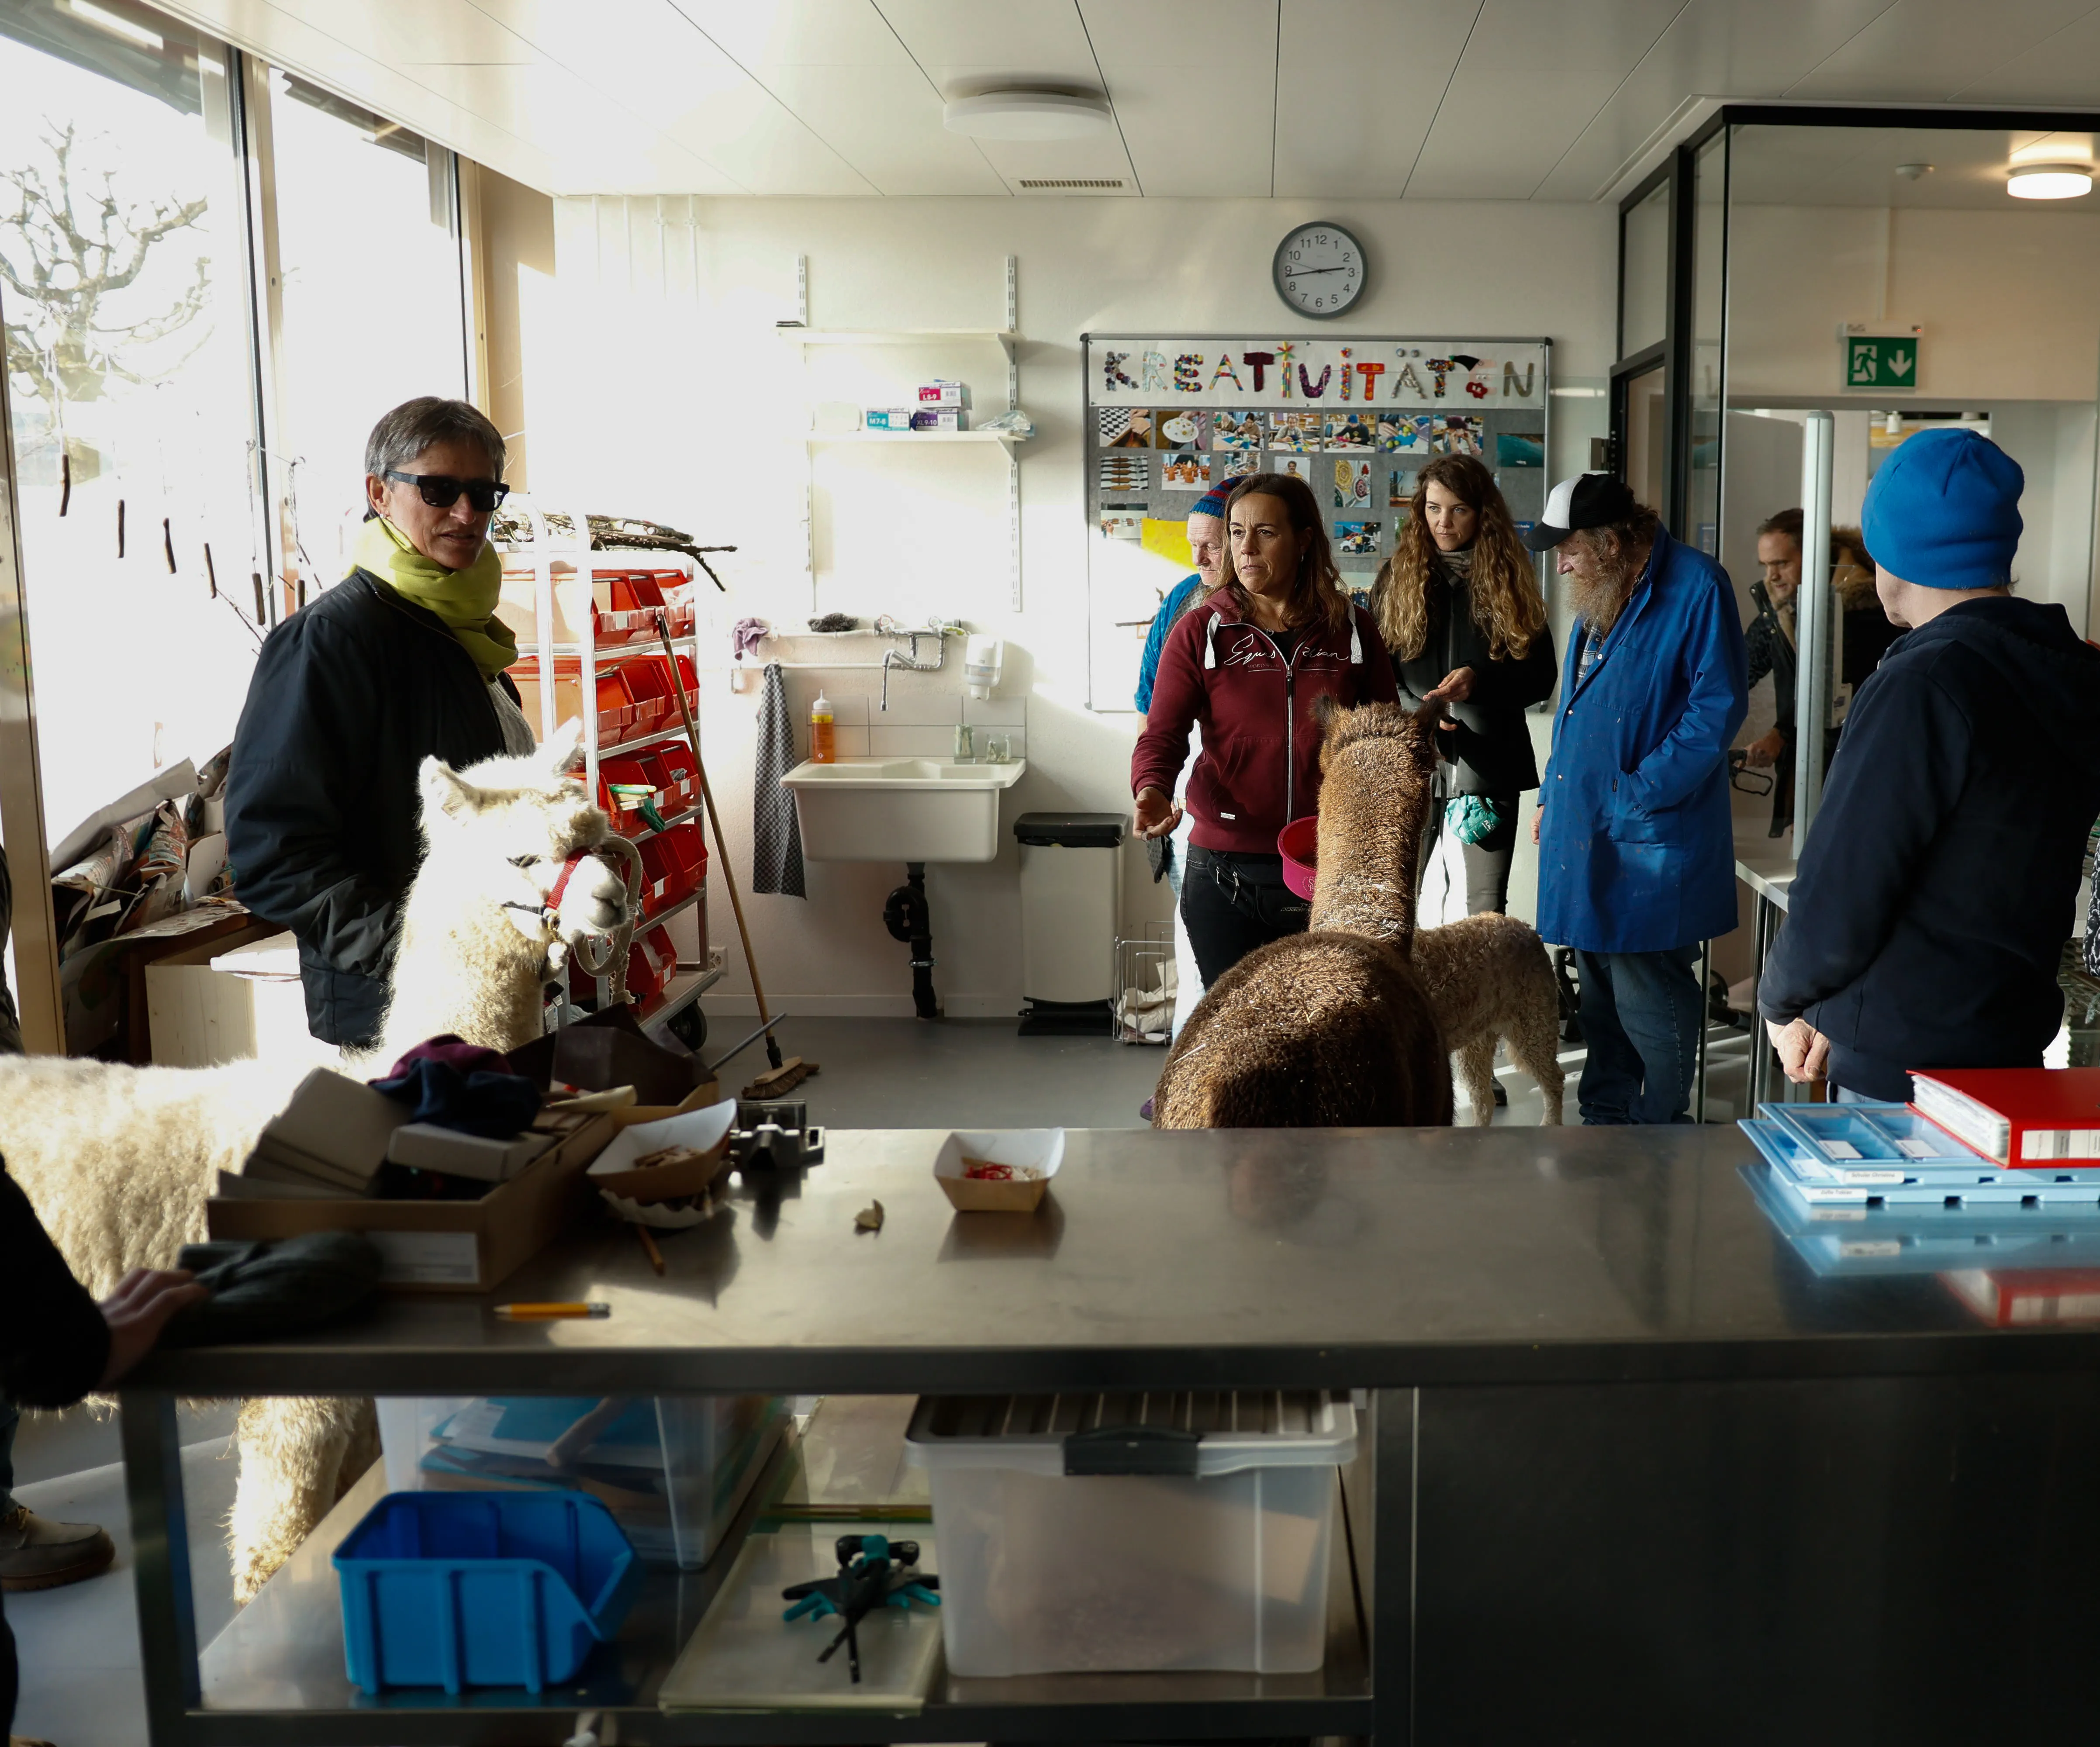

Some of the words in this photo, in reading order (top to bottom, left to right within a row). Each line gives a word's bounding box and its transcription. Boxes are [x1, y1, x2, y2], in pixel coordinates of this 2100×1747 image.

[1300, 238, 1310, 248] 11
[1315, 235, 1327, 244] 12
[1333, 240, 1338, 249] 1
[1289, 251, 1300, 260] 10
[1343, 252, 1350, 262] 2
[1285, 266, 1292, 276] 9
[1348, 267, 1355, 277] 3
[1289, 282, 1296, 291] 8
[1343, 284, 1350, 292] 4
[1301, 293, 1308, 303] 7
[1316, 297, 1323, 307] 6
[1331, 294, 1338, 304] 5
